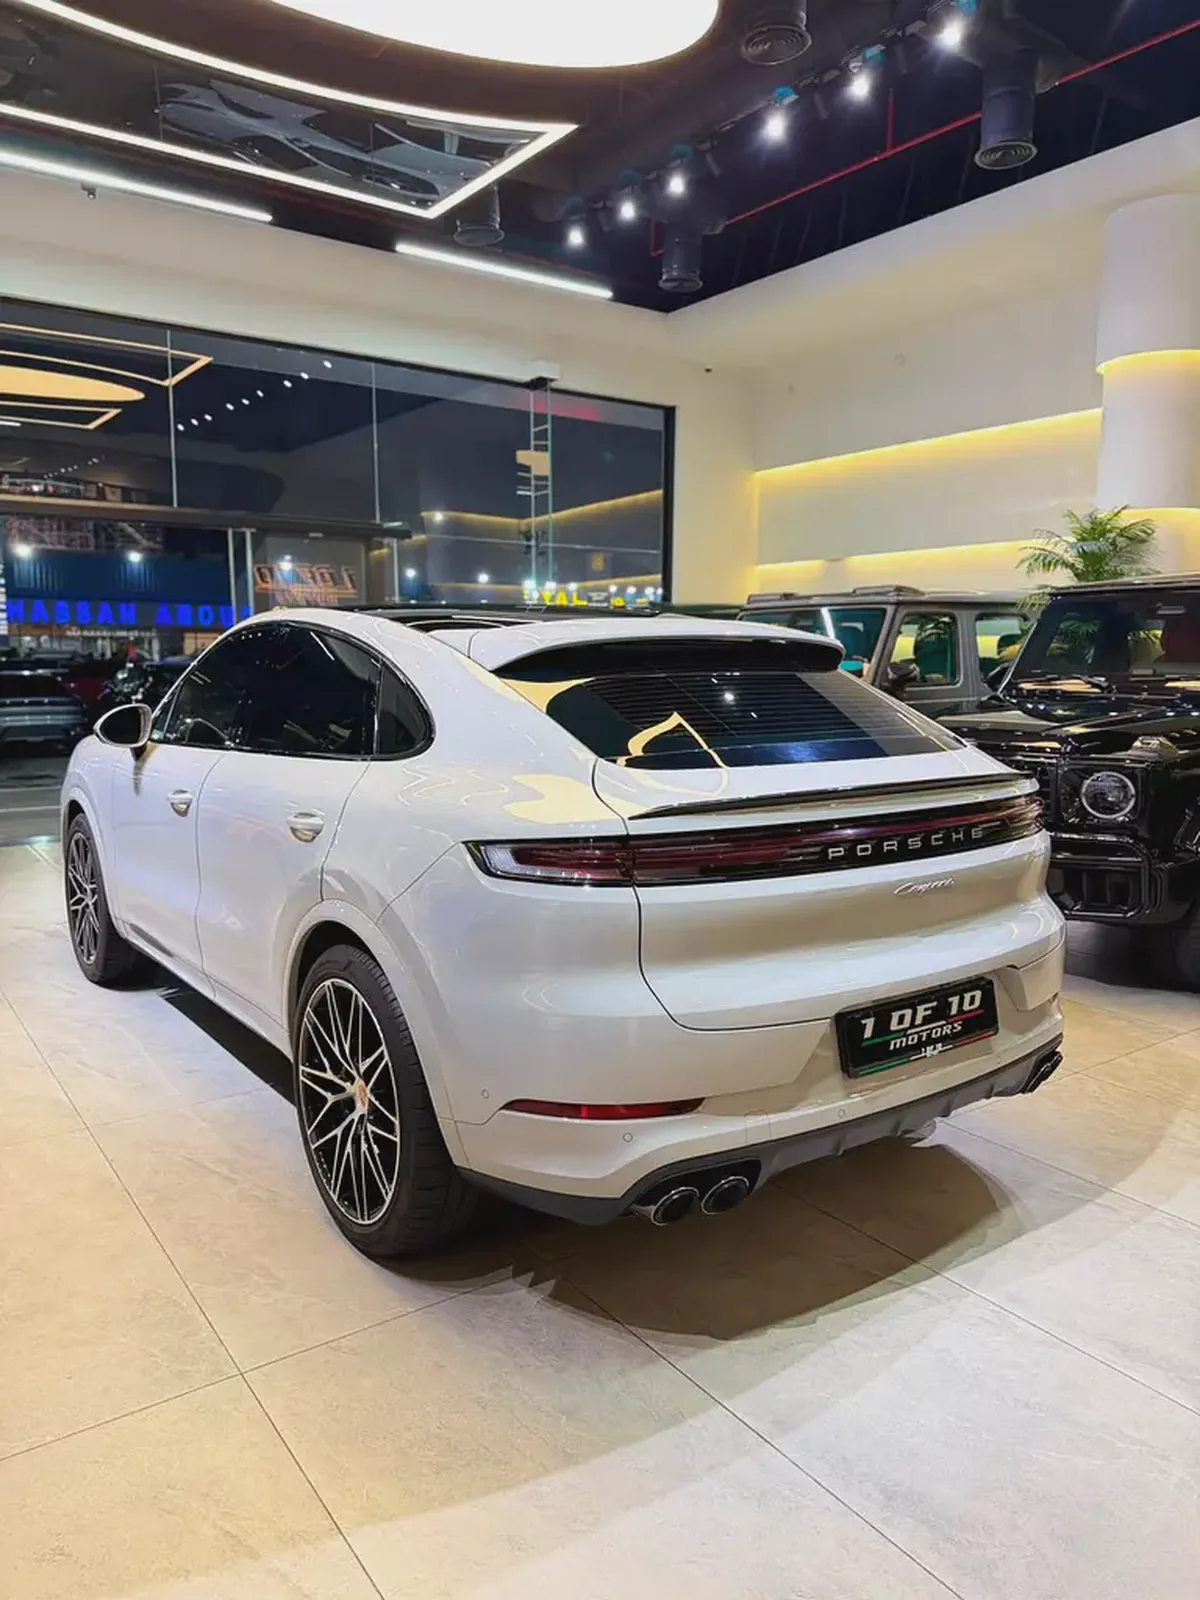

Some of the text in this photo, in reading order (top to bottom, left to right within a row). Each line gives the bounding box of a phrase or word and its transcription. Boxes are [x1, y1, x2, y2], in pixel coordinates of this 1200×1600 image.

[6, 599, 137, 625] HASSAN
[828, 828, 984, 861] PORSCHE
[861, 989, 983, 1039] 1 OF 10
[889, 1020, 963, 1051] MOTORS
